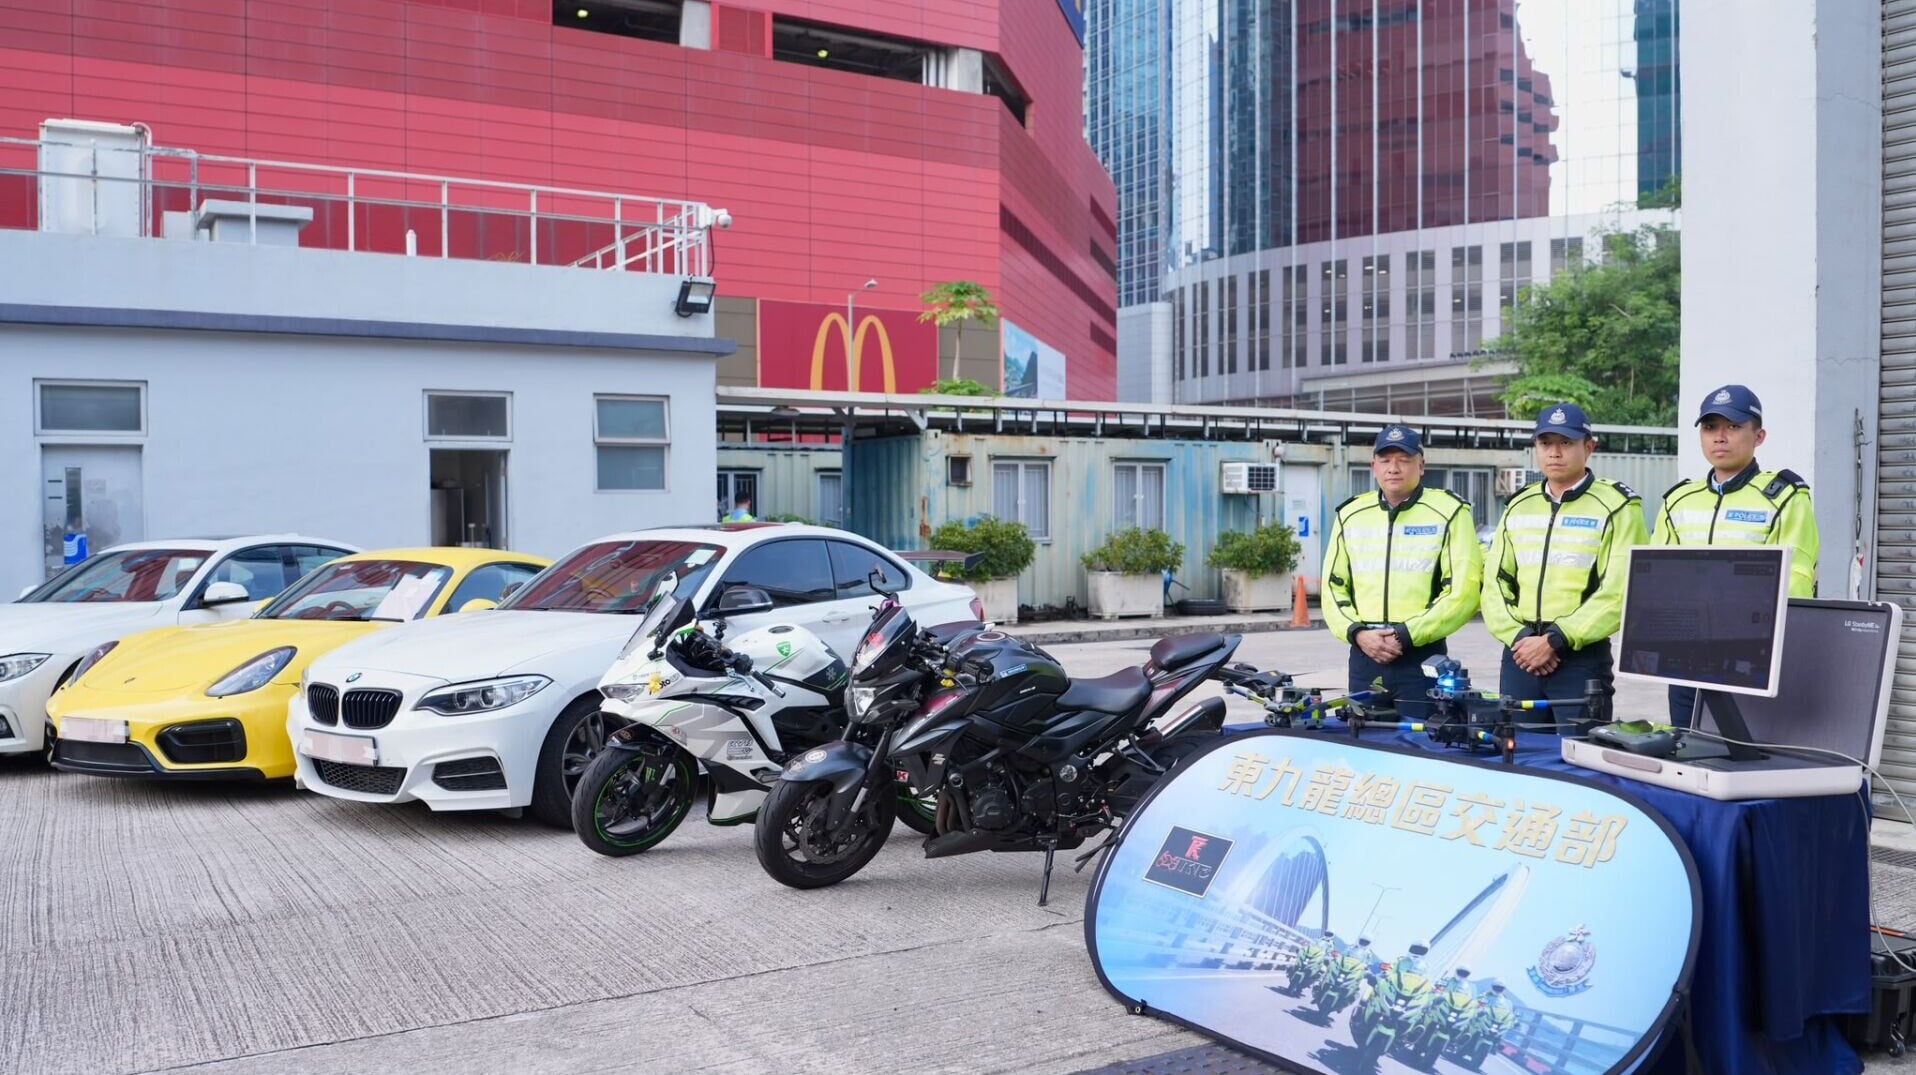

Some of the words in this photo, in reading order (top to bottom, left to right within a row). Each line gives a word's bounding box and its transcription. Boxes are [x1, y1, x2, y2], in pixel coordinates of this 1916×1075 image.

[1218, 752, 1630, 868] 東九龍總區交通部
